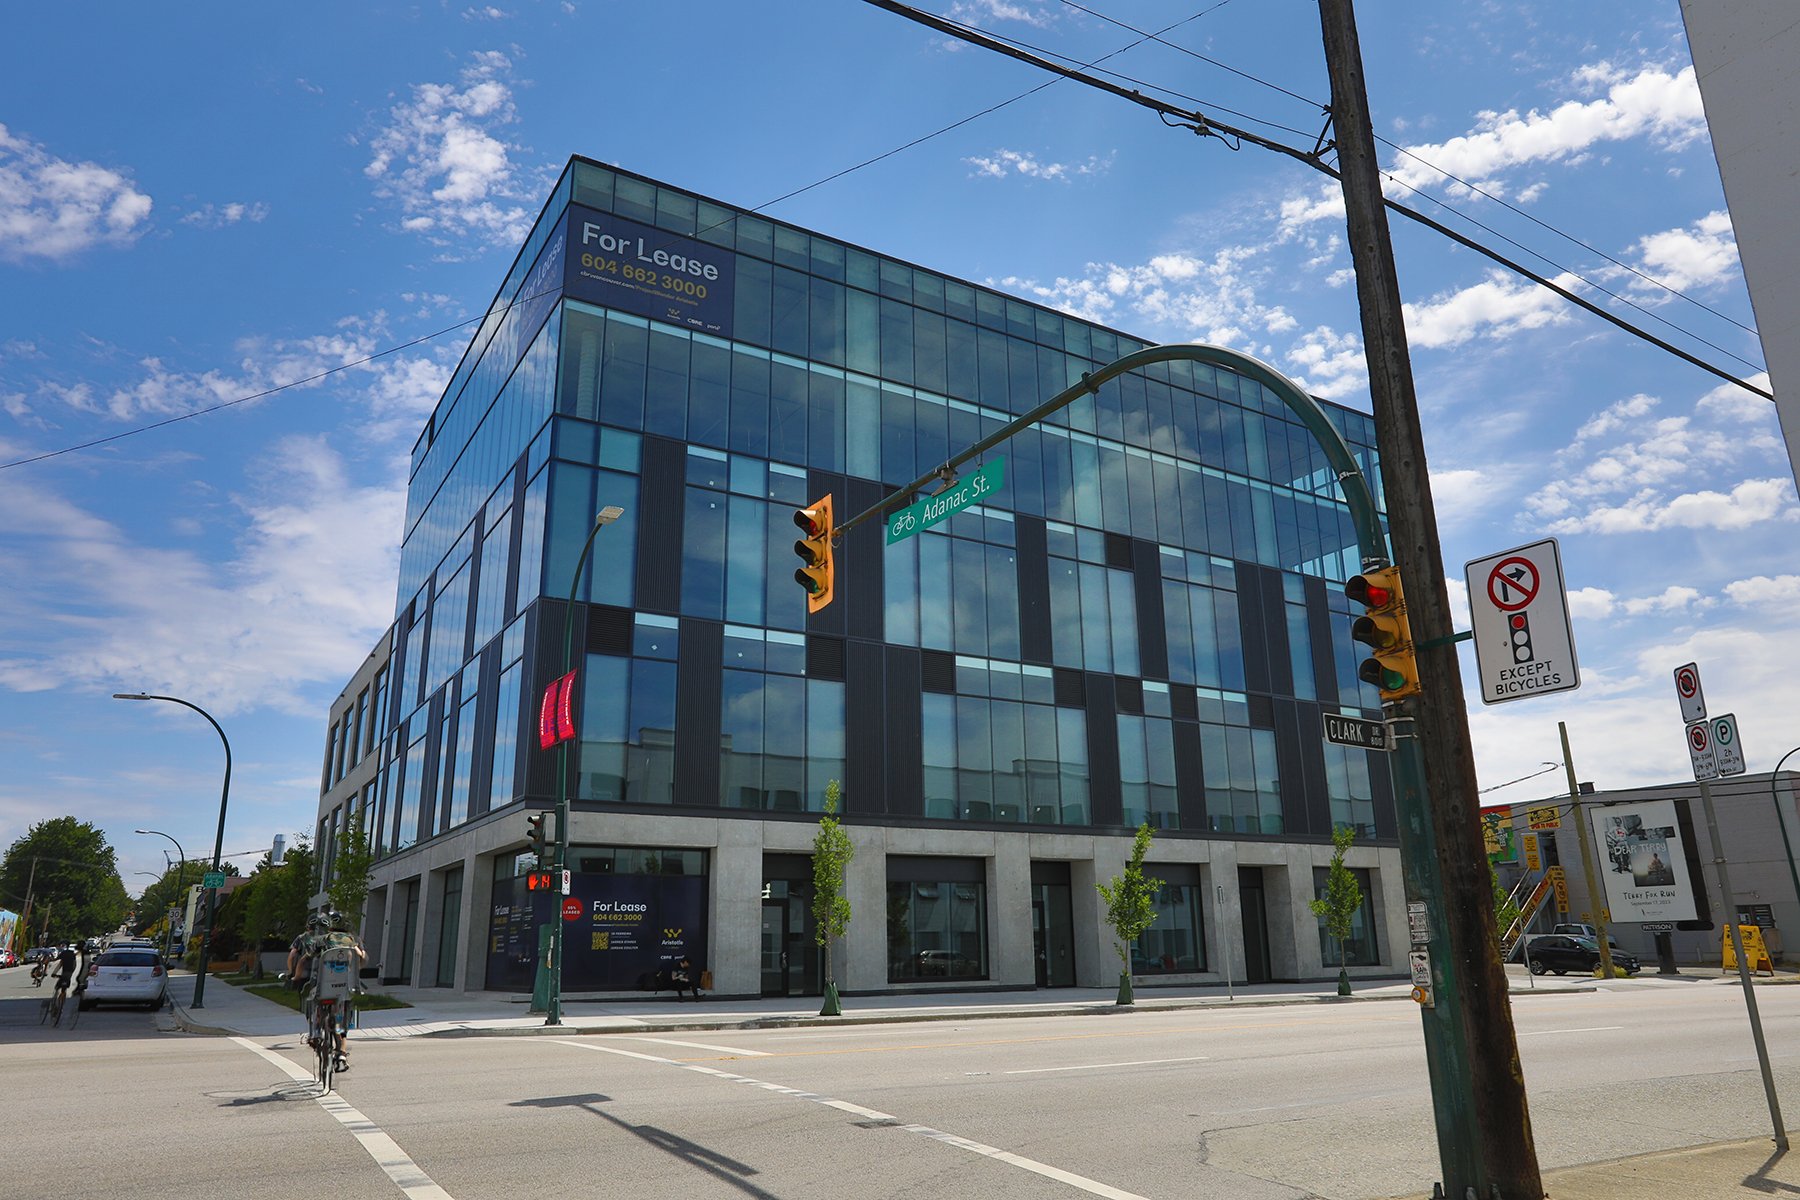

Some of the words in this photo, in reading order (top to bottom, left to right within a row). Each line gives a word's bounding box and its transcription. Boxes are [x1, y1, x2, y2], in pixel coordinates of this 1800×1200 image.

[582, 221, 630, 255] For
[637, 237, 719, 281] Lease
[581, 253, 618, 274] 604
[622, 264, 657, 286] 662
[661, 274, 707, 299] 3000
[922, 488, 968, 524] Adanac
[972, 475, 990, 498] St.
[1500, 660, 1552, 681] EXCEPT
[1496, 673, 1562, 695] BICYCLES
[1330, 719, 1365, 743] CLARK
[1719, 725, 1729, 741] P
[1613, 844, 1637, 856] DEAR
[1638, 842, 1666, 853] TERRY
[593, 900, 612, 911] For
[614, 900, 647, 911] Lease
[1623, 891, 1643, 900] TERRY
[1660, 890, 1676, 898] RUN
